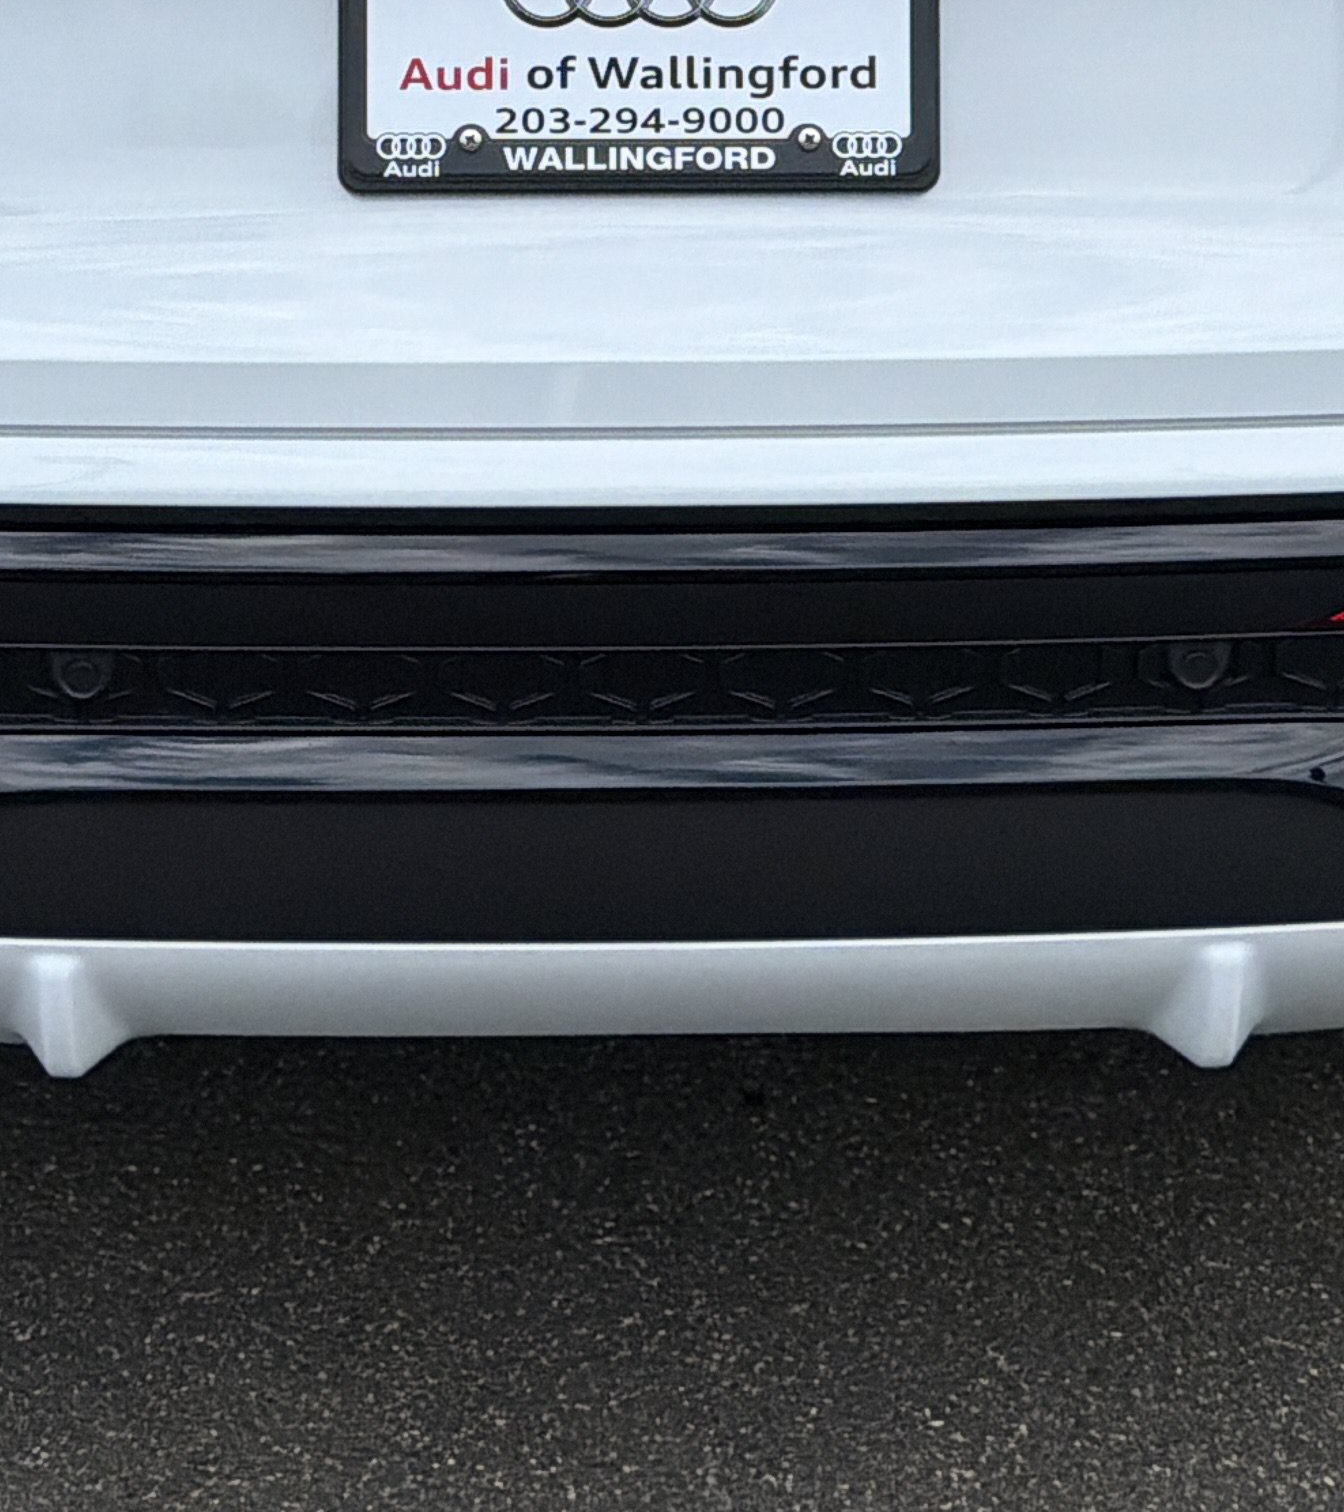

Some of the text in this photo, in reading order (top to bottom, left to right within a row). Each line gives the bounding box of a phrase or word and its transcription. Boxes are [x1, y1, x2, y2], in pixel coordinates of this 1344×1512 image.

[399, 55, 878, 99] Audi of Wallingford
[494, 107, 785, 135] 203-294-9000
[383, 160, 440, 178] Audi
[503, 146, 776, 171] WALLINGFORD
[839, 159, 897, 177] Audi
